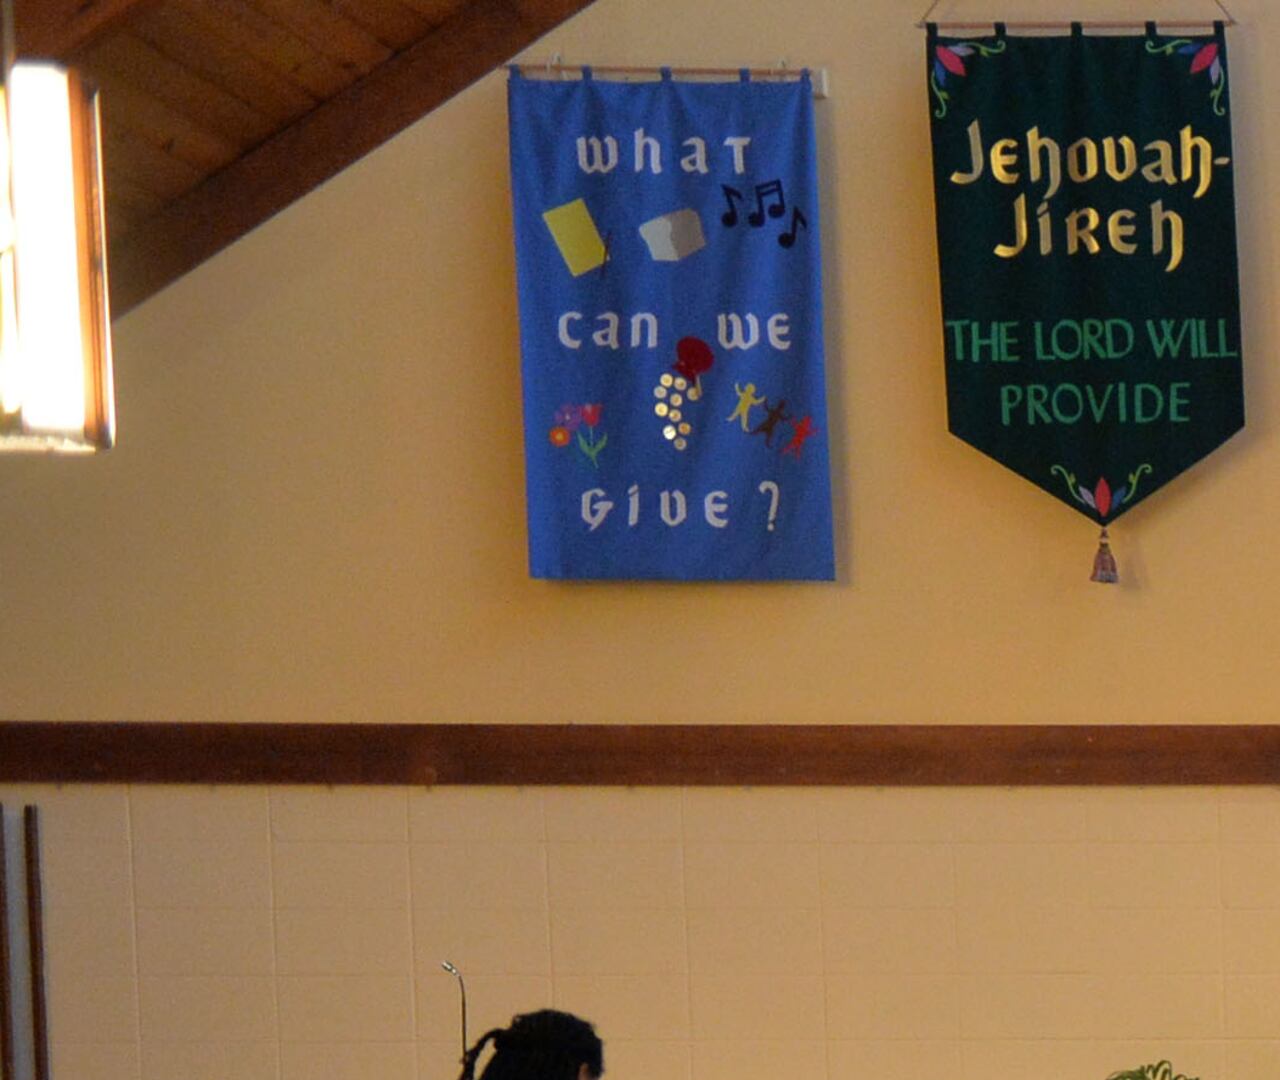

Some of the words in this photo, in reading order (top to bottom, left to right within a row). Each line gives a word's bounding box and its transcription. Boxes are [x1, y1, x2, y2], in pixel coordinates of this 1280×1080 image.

[950, 118, 1231, 198] Jehovah-
[557, 311, 659, 350] can
[947, 318, 1018, 363] THE
[1034, 318, 1134, 361] LORD
[1149, 317, 1238, 358] WILL
[1000, 382, 1191, 426] PROVIDE
